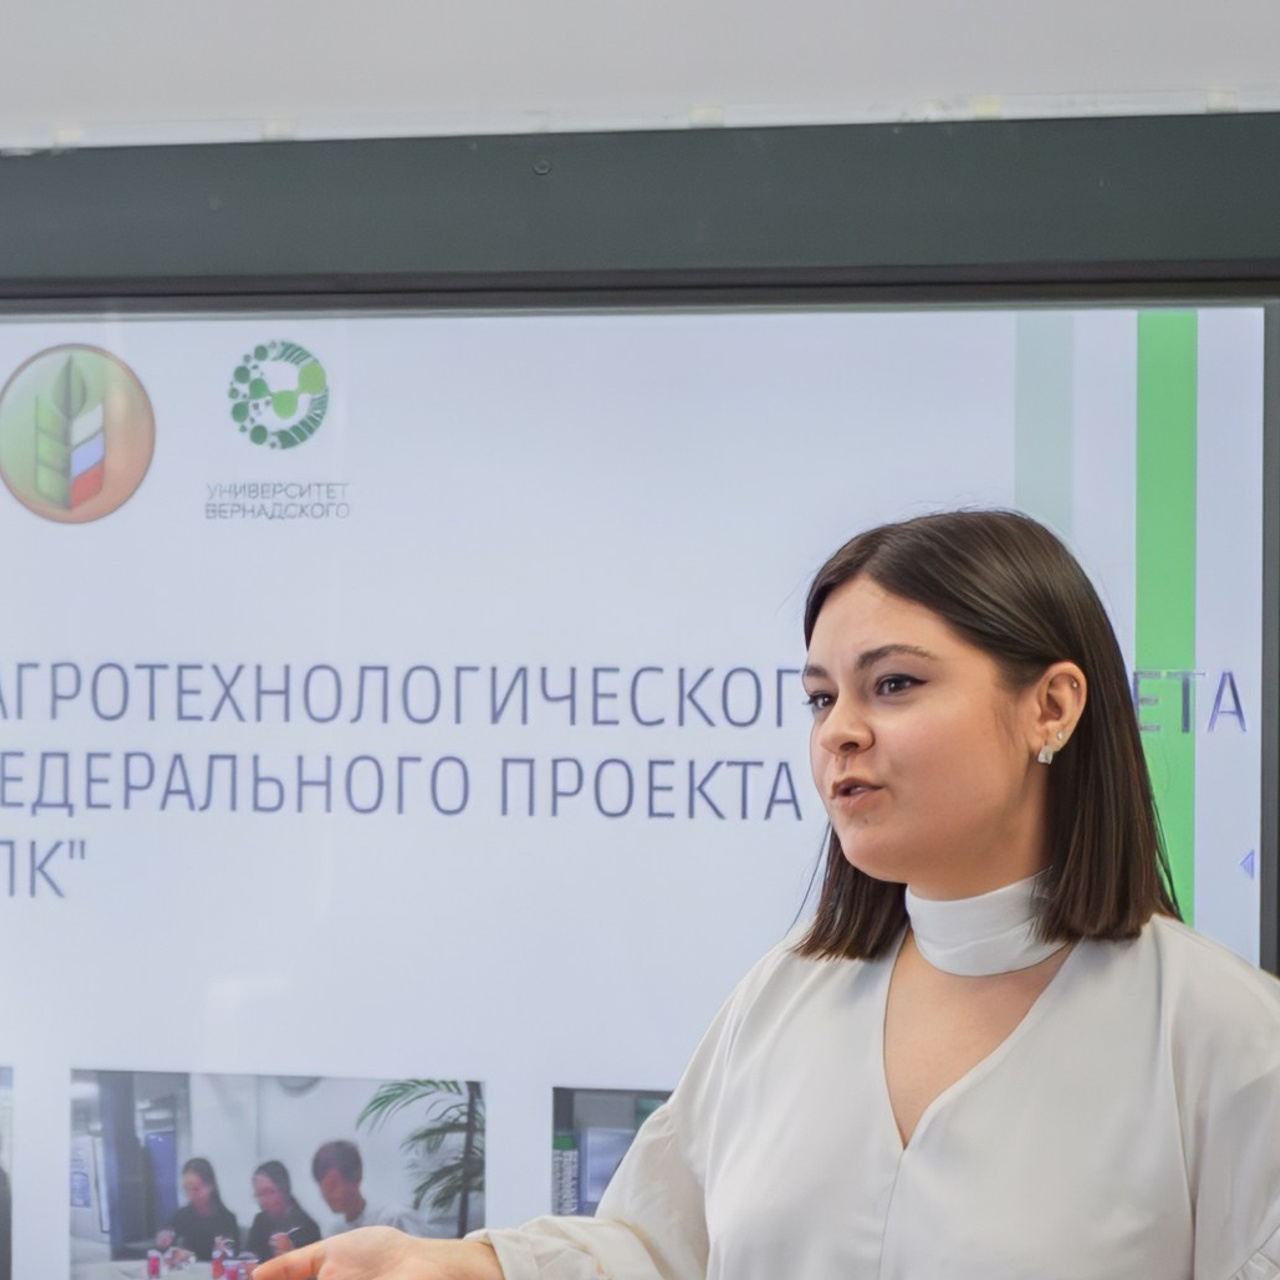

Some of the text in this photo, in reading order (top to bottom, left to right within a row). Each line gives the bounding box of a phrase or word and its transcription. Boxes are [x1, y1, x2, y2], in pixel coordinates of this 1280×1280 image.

[206, 482, 349, 499] УНИВЕРСИТЕТ
[204, 502, 350, 520] ВЕРНАДСКОГО
[1133, 670, 1247, 733] ЕТА
[500, 757, 803, 821] ПРОЕКТА
